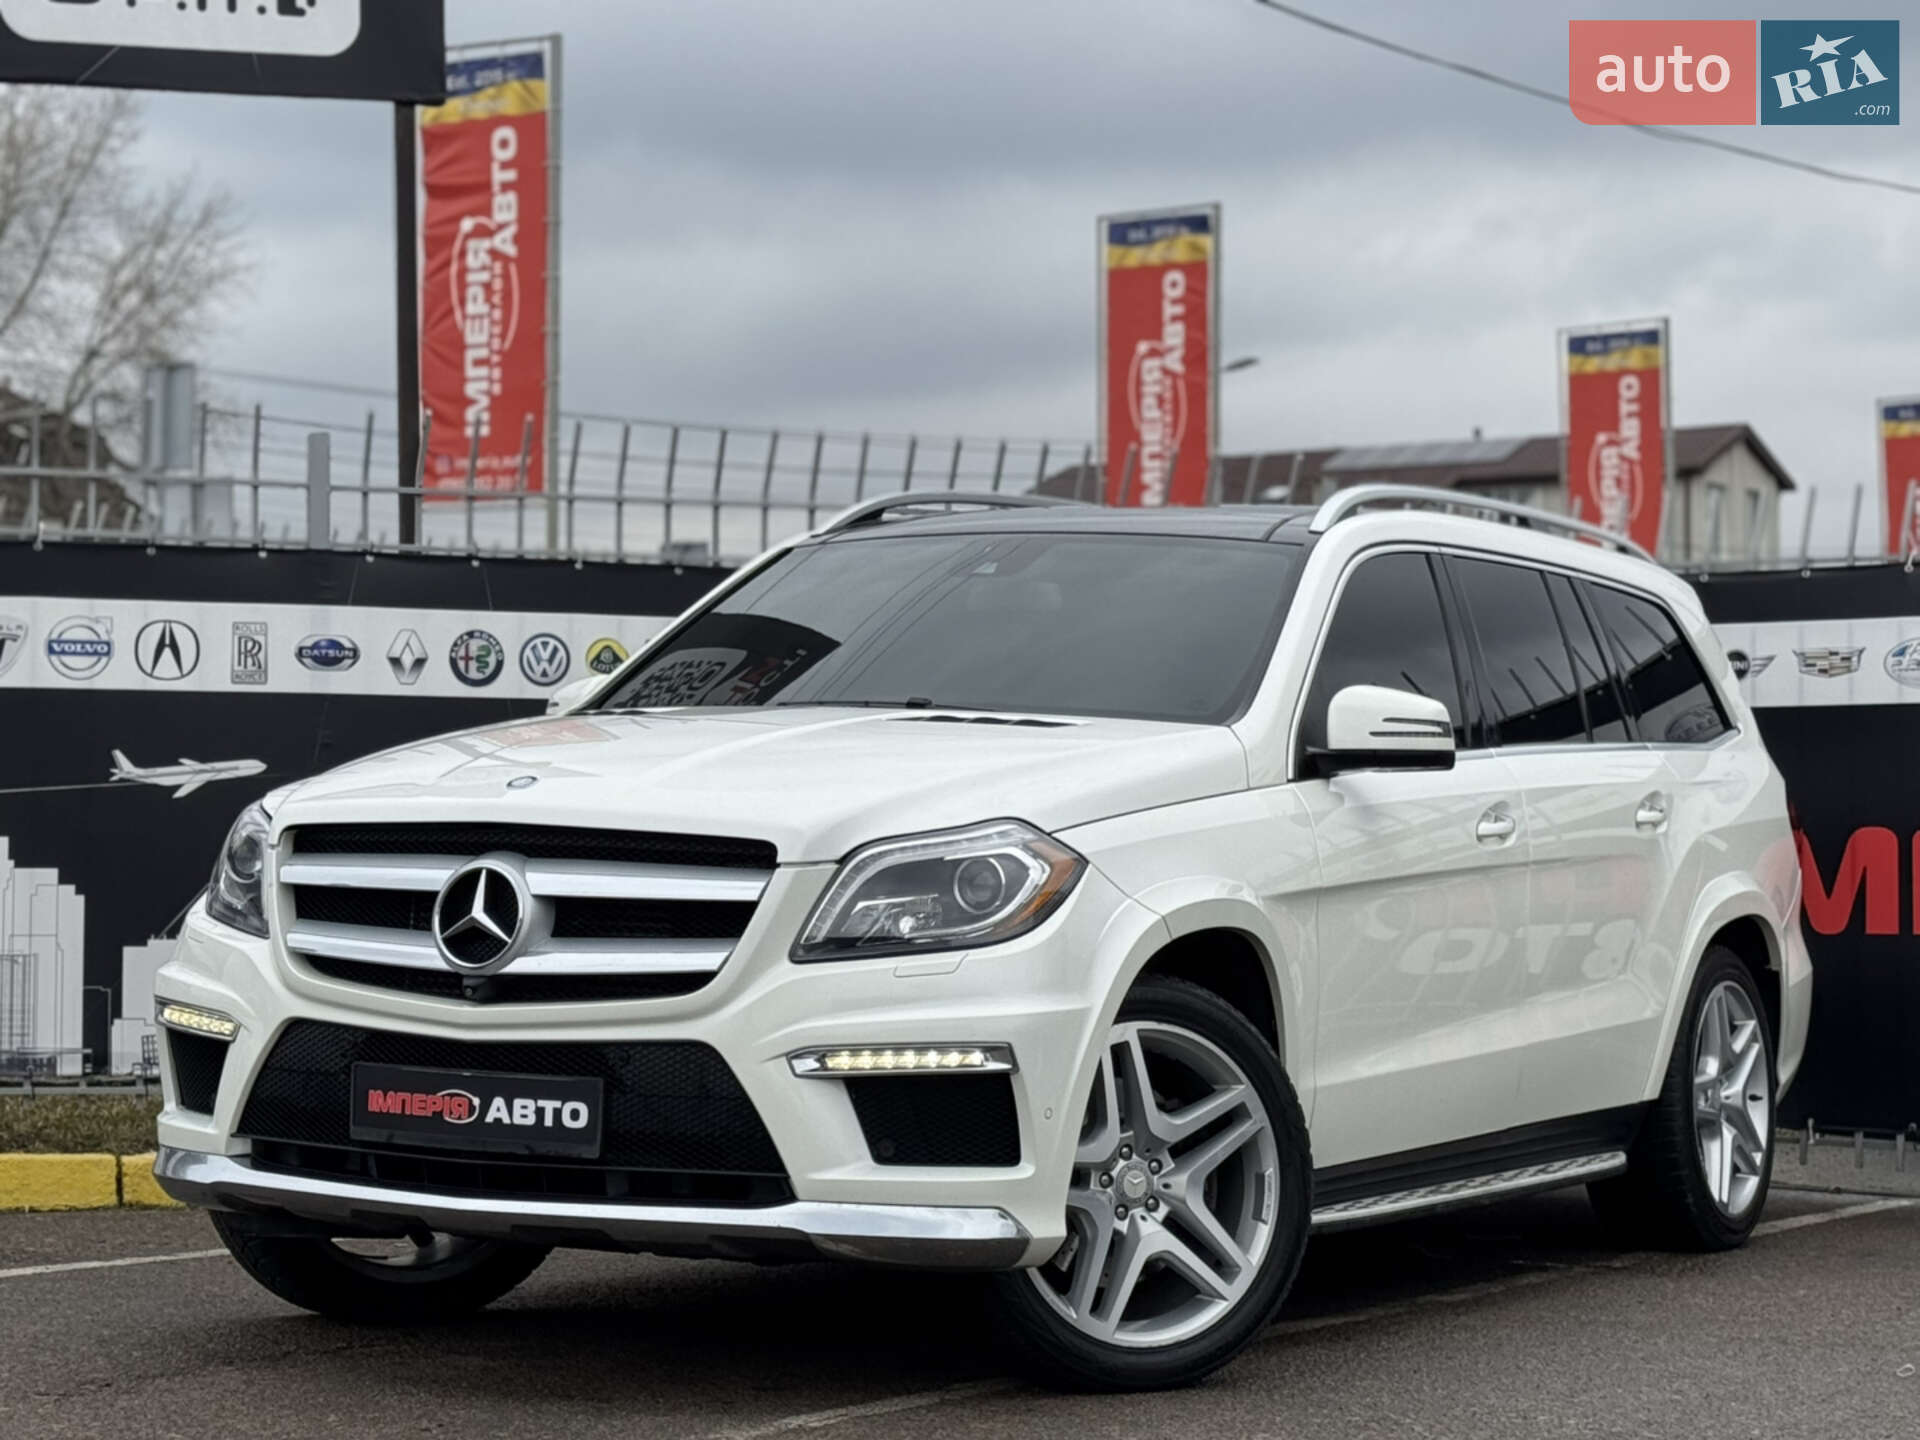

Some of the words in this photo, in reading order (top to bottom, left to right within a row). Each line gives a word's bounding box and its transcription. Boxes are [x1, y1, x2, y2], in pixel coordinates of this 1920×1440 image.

[490, 126, 518, 257] АВТО
[464, 237, 491, 438] ІМПЕРІЯ
[1162, 270, 1185, 374] АВТО
[1619, 374, 1641, 460] АВТО
[51, 643, 109, 654] VOLVO
[301, 648, 354, 658] DATSUN
[1792, 826, 1920, 935] М
[368, 1089, 470, 1119] ІМПЕРІЯ
[484, 1096, 589, 1129] АВТО
